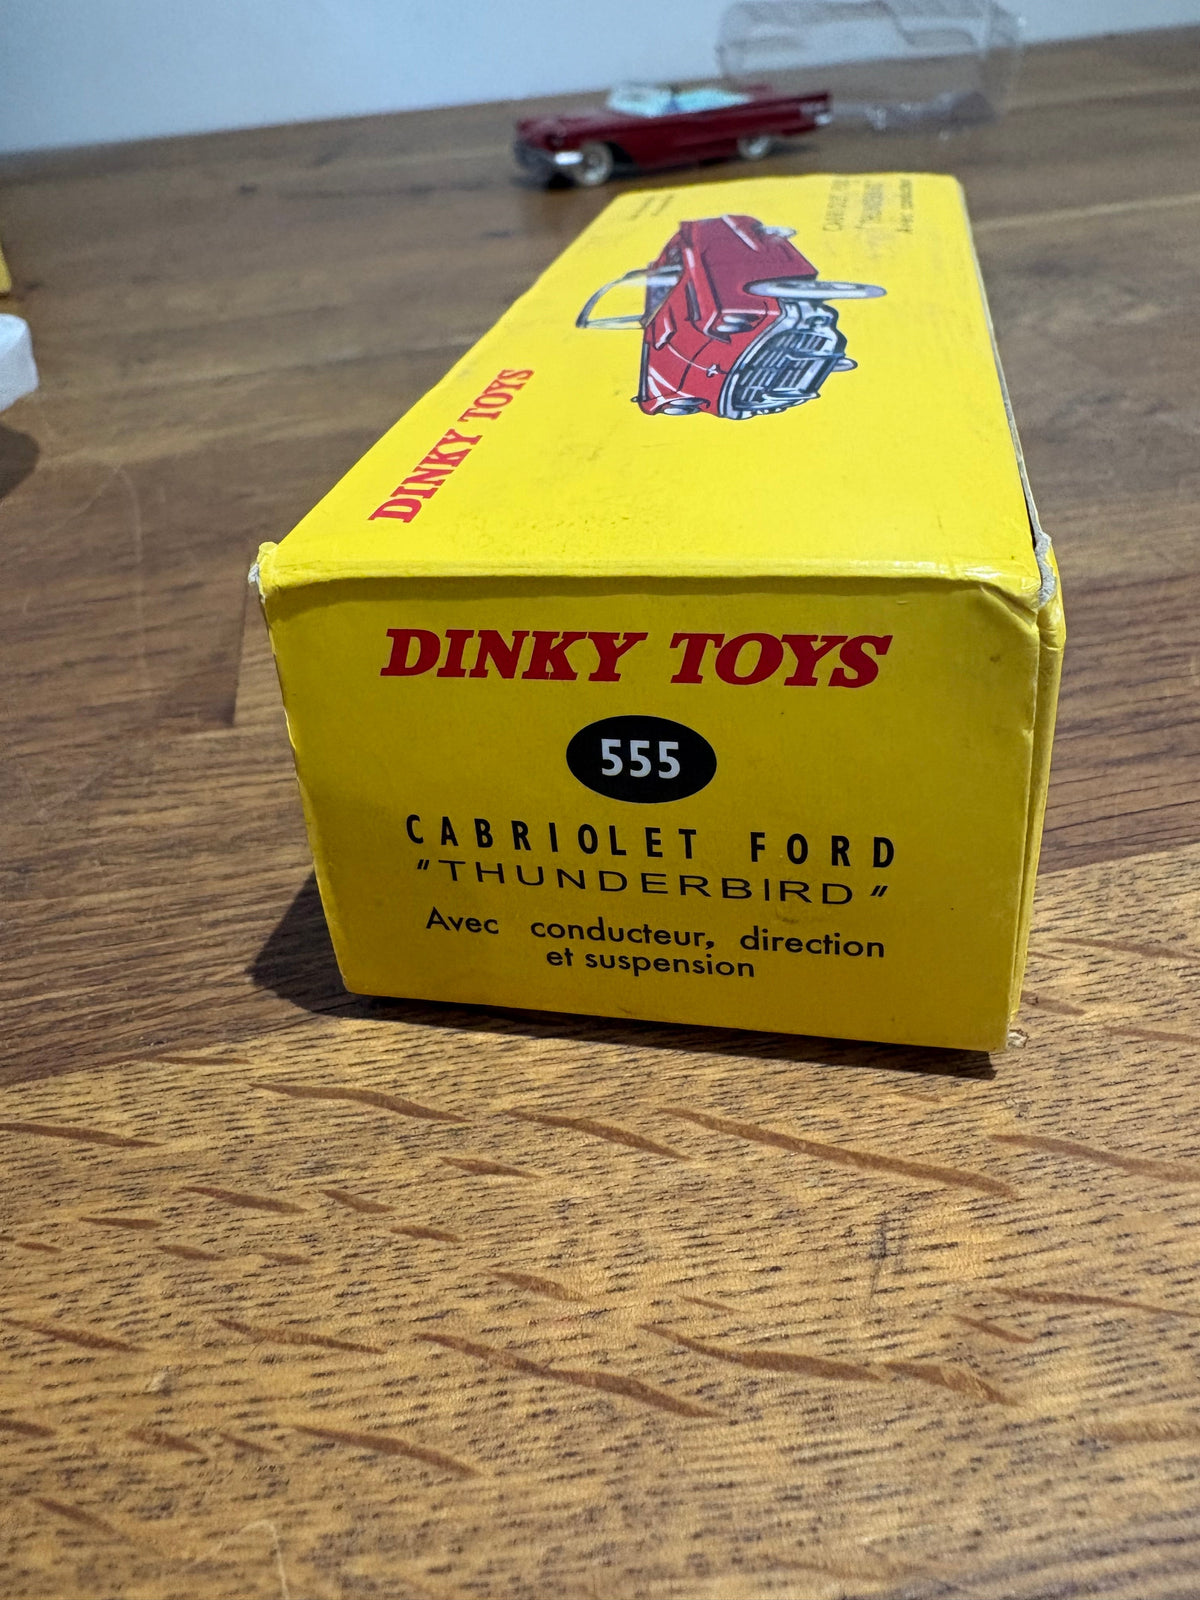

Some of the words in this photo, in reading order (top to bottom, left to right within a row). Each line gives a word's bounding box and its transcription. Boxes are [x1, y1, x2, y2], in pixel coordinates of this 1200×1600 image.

[367, 429, 483, 523] DINKY
[457, 369, 535, 422] TOYS
[380, 628, 648, 682] DINKY
[669, 632, 893, 688] TOYS
[600, 738, 681, 779] 555
[406, 814, 697, 860] CABRIOLET
[750, 831, 895, 870] FORD
[426, 907, 499, 936] Avec
[530, 917, 715, 950] conducteur,
[740, 926, 885, 957] direction
[546, 947, 574, 967] et
[584, 951, 755, 978] suspension
